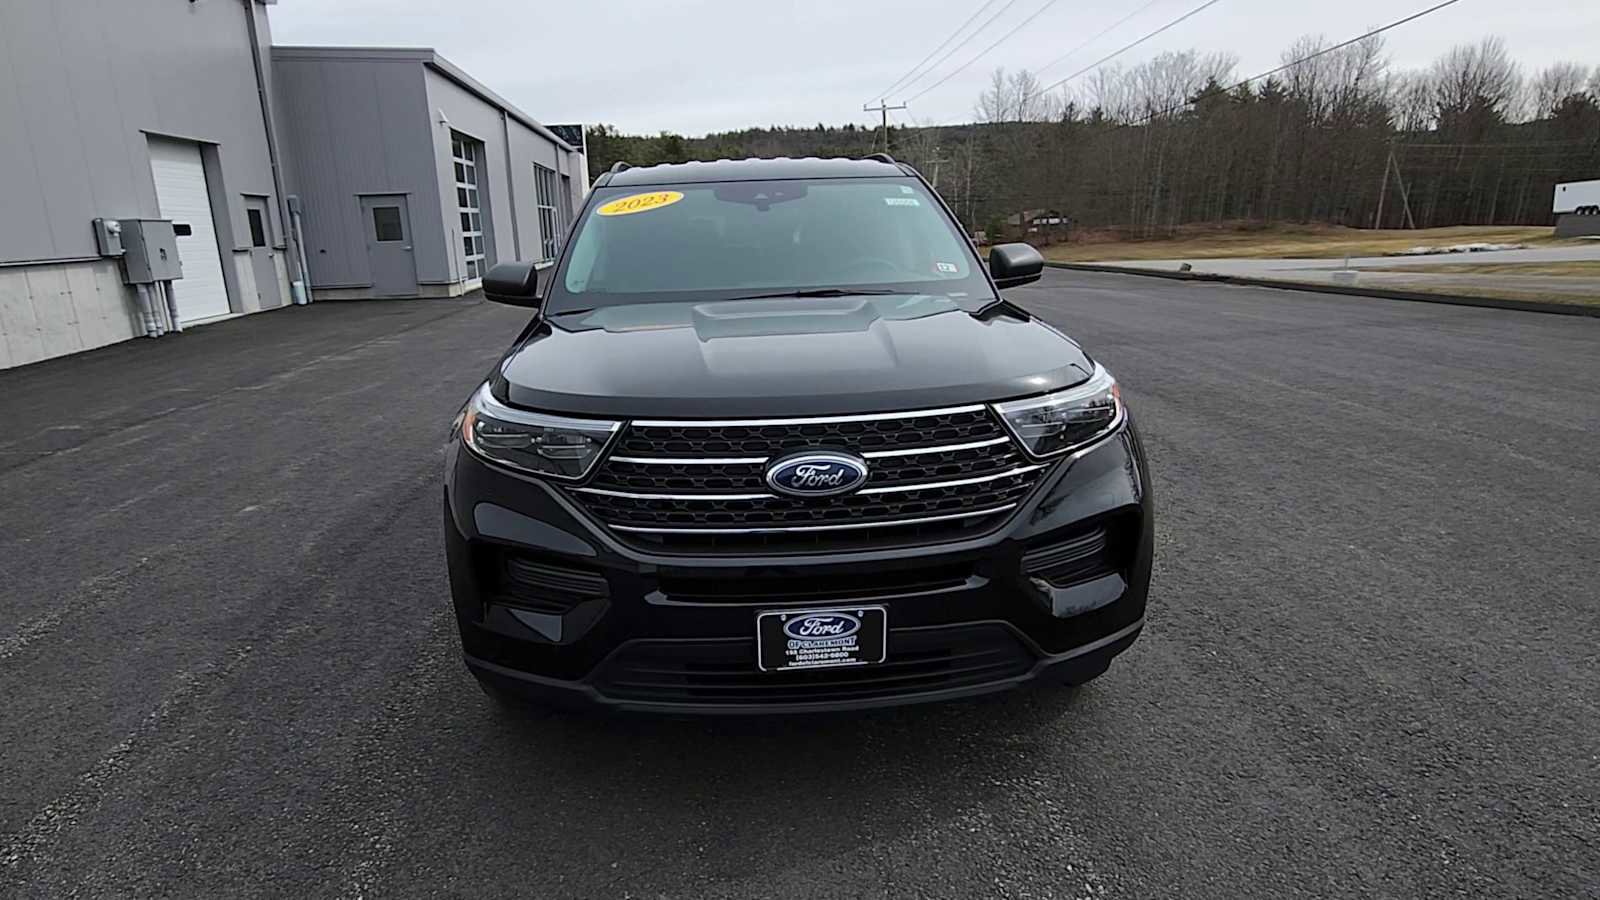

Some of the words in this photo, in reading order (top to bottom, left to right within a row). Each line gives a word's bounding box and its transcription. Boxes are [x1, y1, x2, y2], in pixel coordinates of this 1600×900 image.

[614, 193, 669, 212] 2023
[791, 464, 845, 487] Ford
[799, 617, 845, 635] Ford
[788, 639, 801, 649] OF
[801, 635, 857, 649] CLAREMONT
